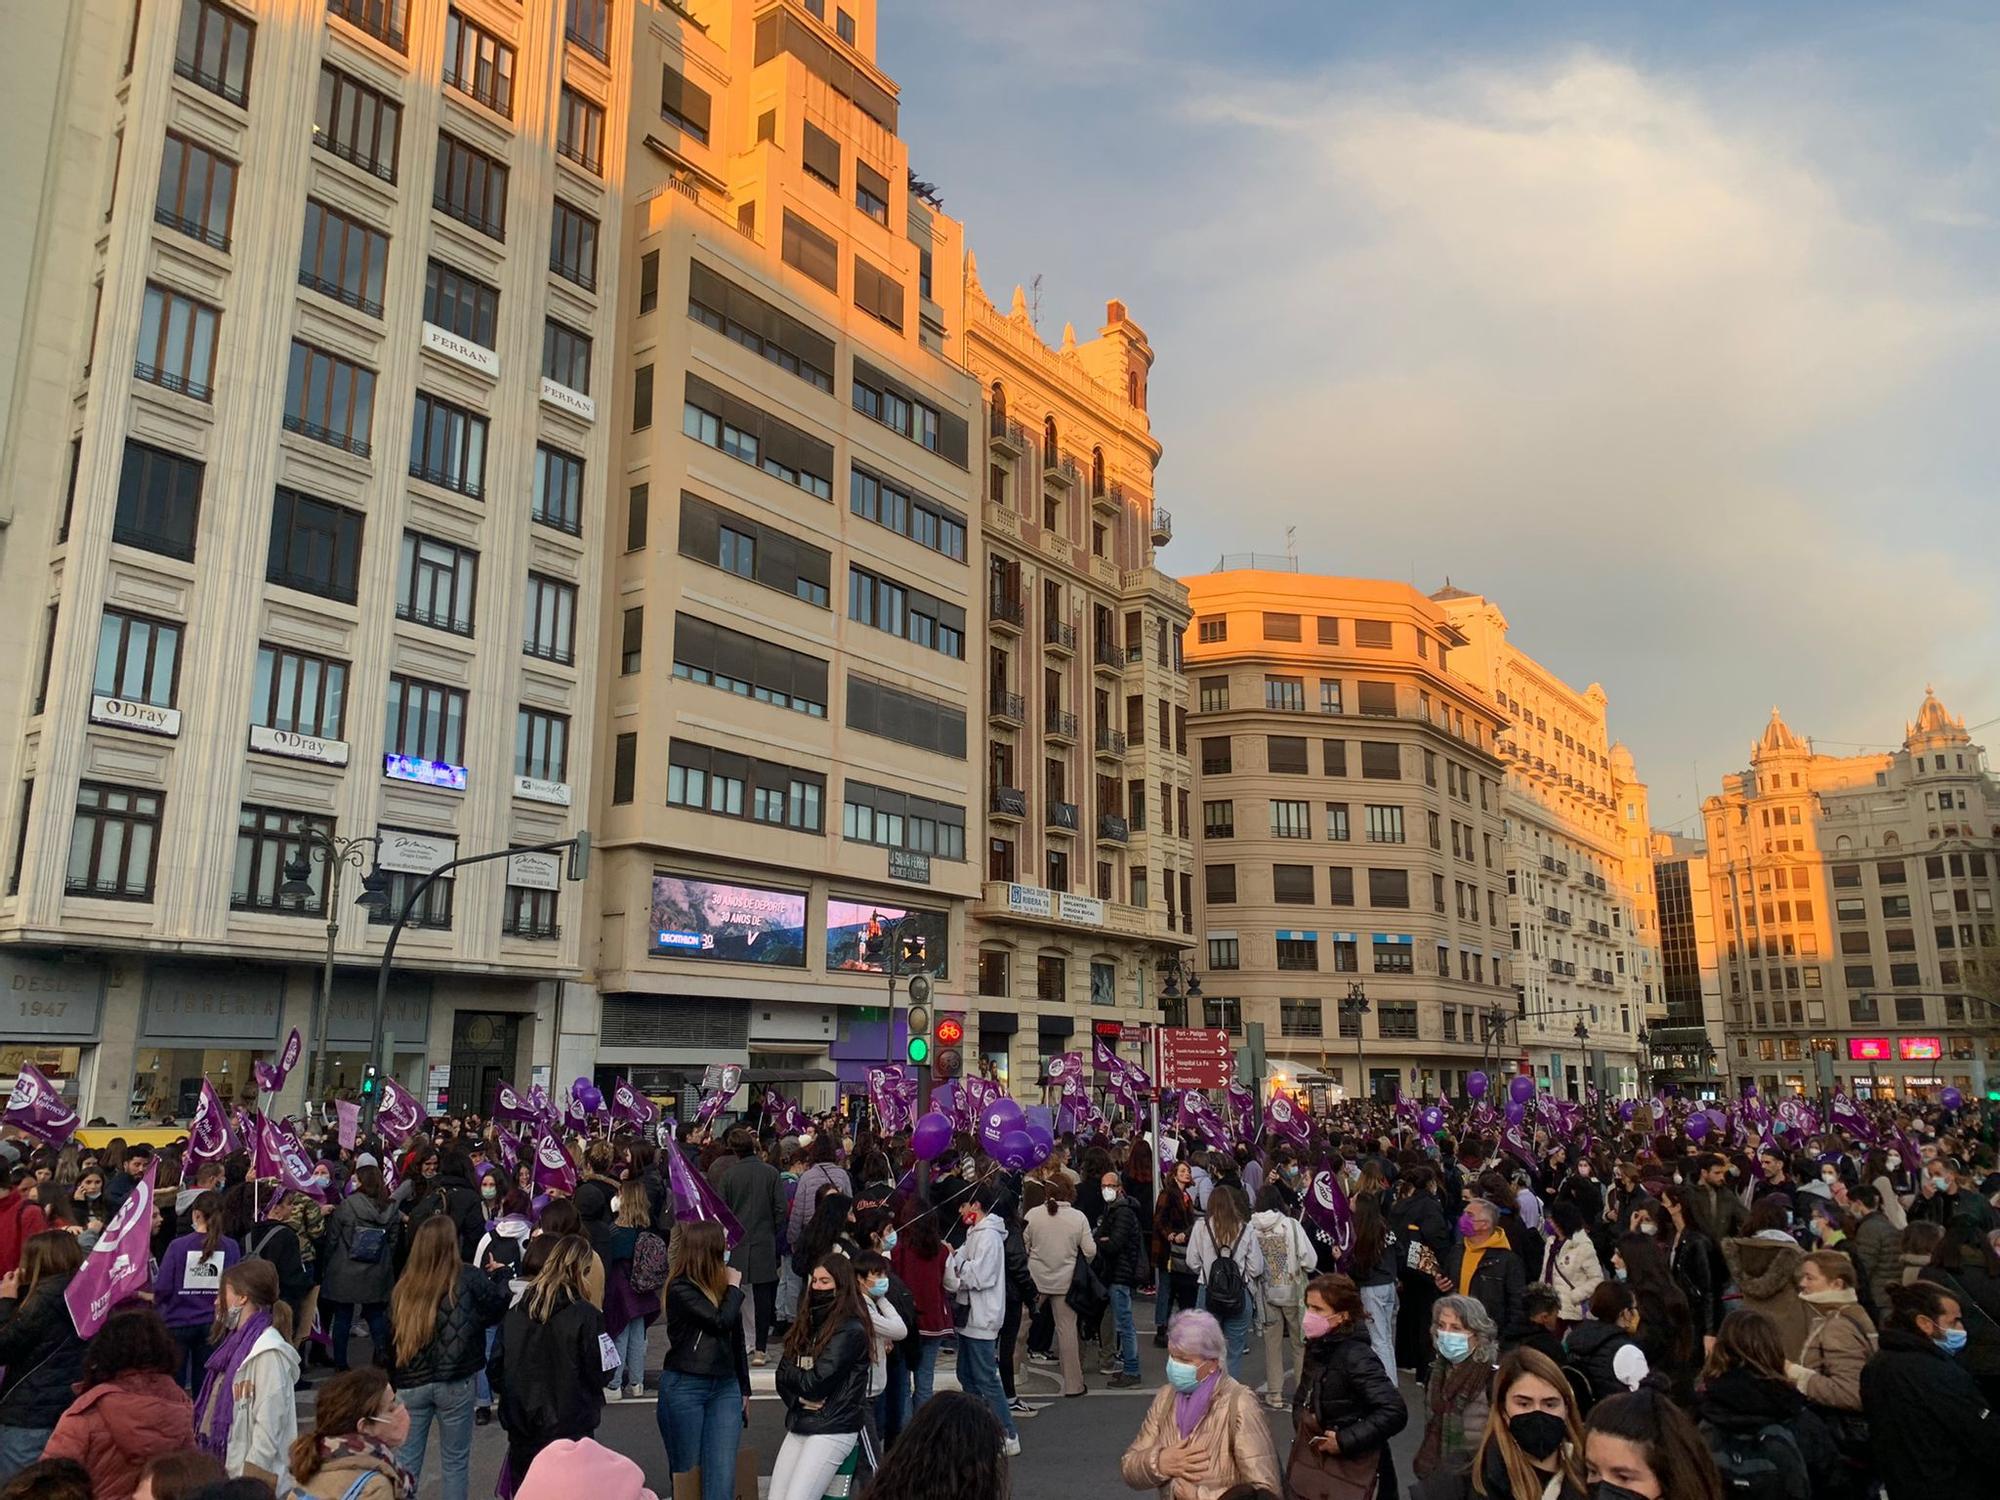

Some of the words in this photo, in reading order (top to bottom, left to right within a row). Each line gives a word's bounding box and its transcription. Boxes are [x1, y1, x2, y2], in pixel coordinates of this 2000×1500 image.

[432, 333, 488, 364] FERRAN
[543, 385, 591, 412] FERRAN
[712, 894, 722, 905] 30
[754, 899, 786, 913] DEPORTE
[720, 911, 730, 923] 30
[730, 910, 751, 925] AÑOS
[751, 913, 762, 926] DE
[11, 975, 82, 993] DESDE
[19, 1001, 69, 1018] 1947
[1176, 1060, 1196, 1068] Hospital
[16, 1079, 36, 1096] GT
[38, 1091, 55, 1103] País
